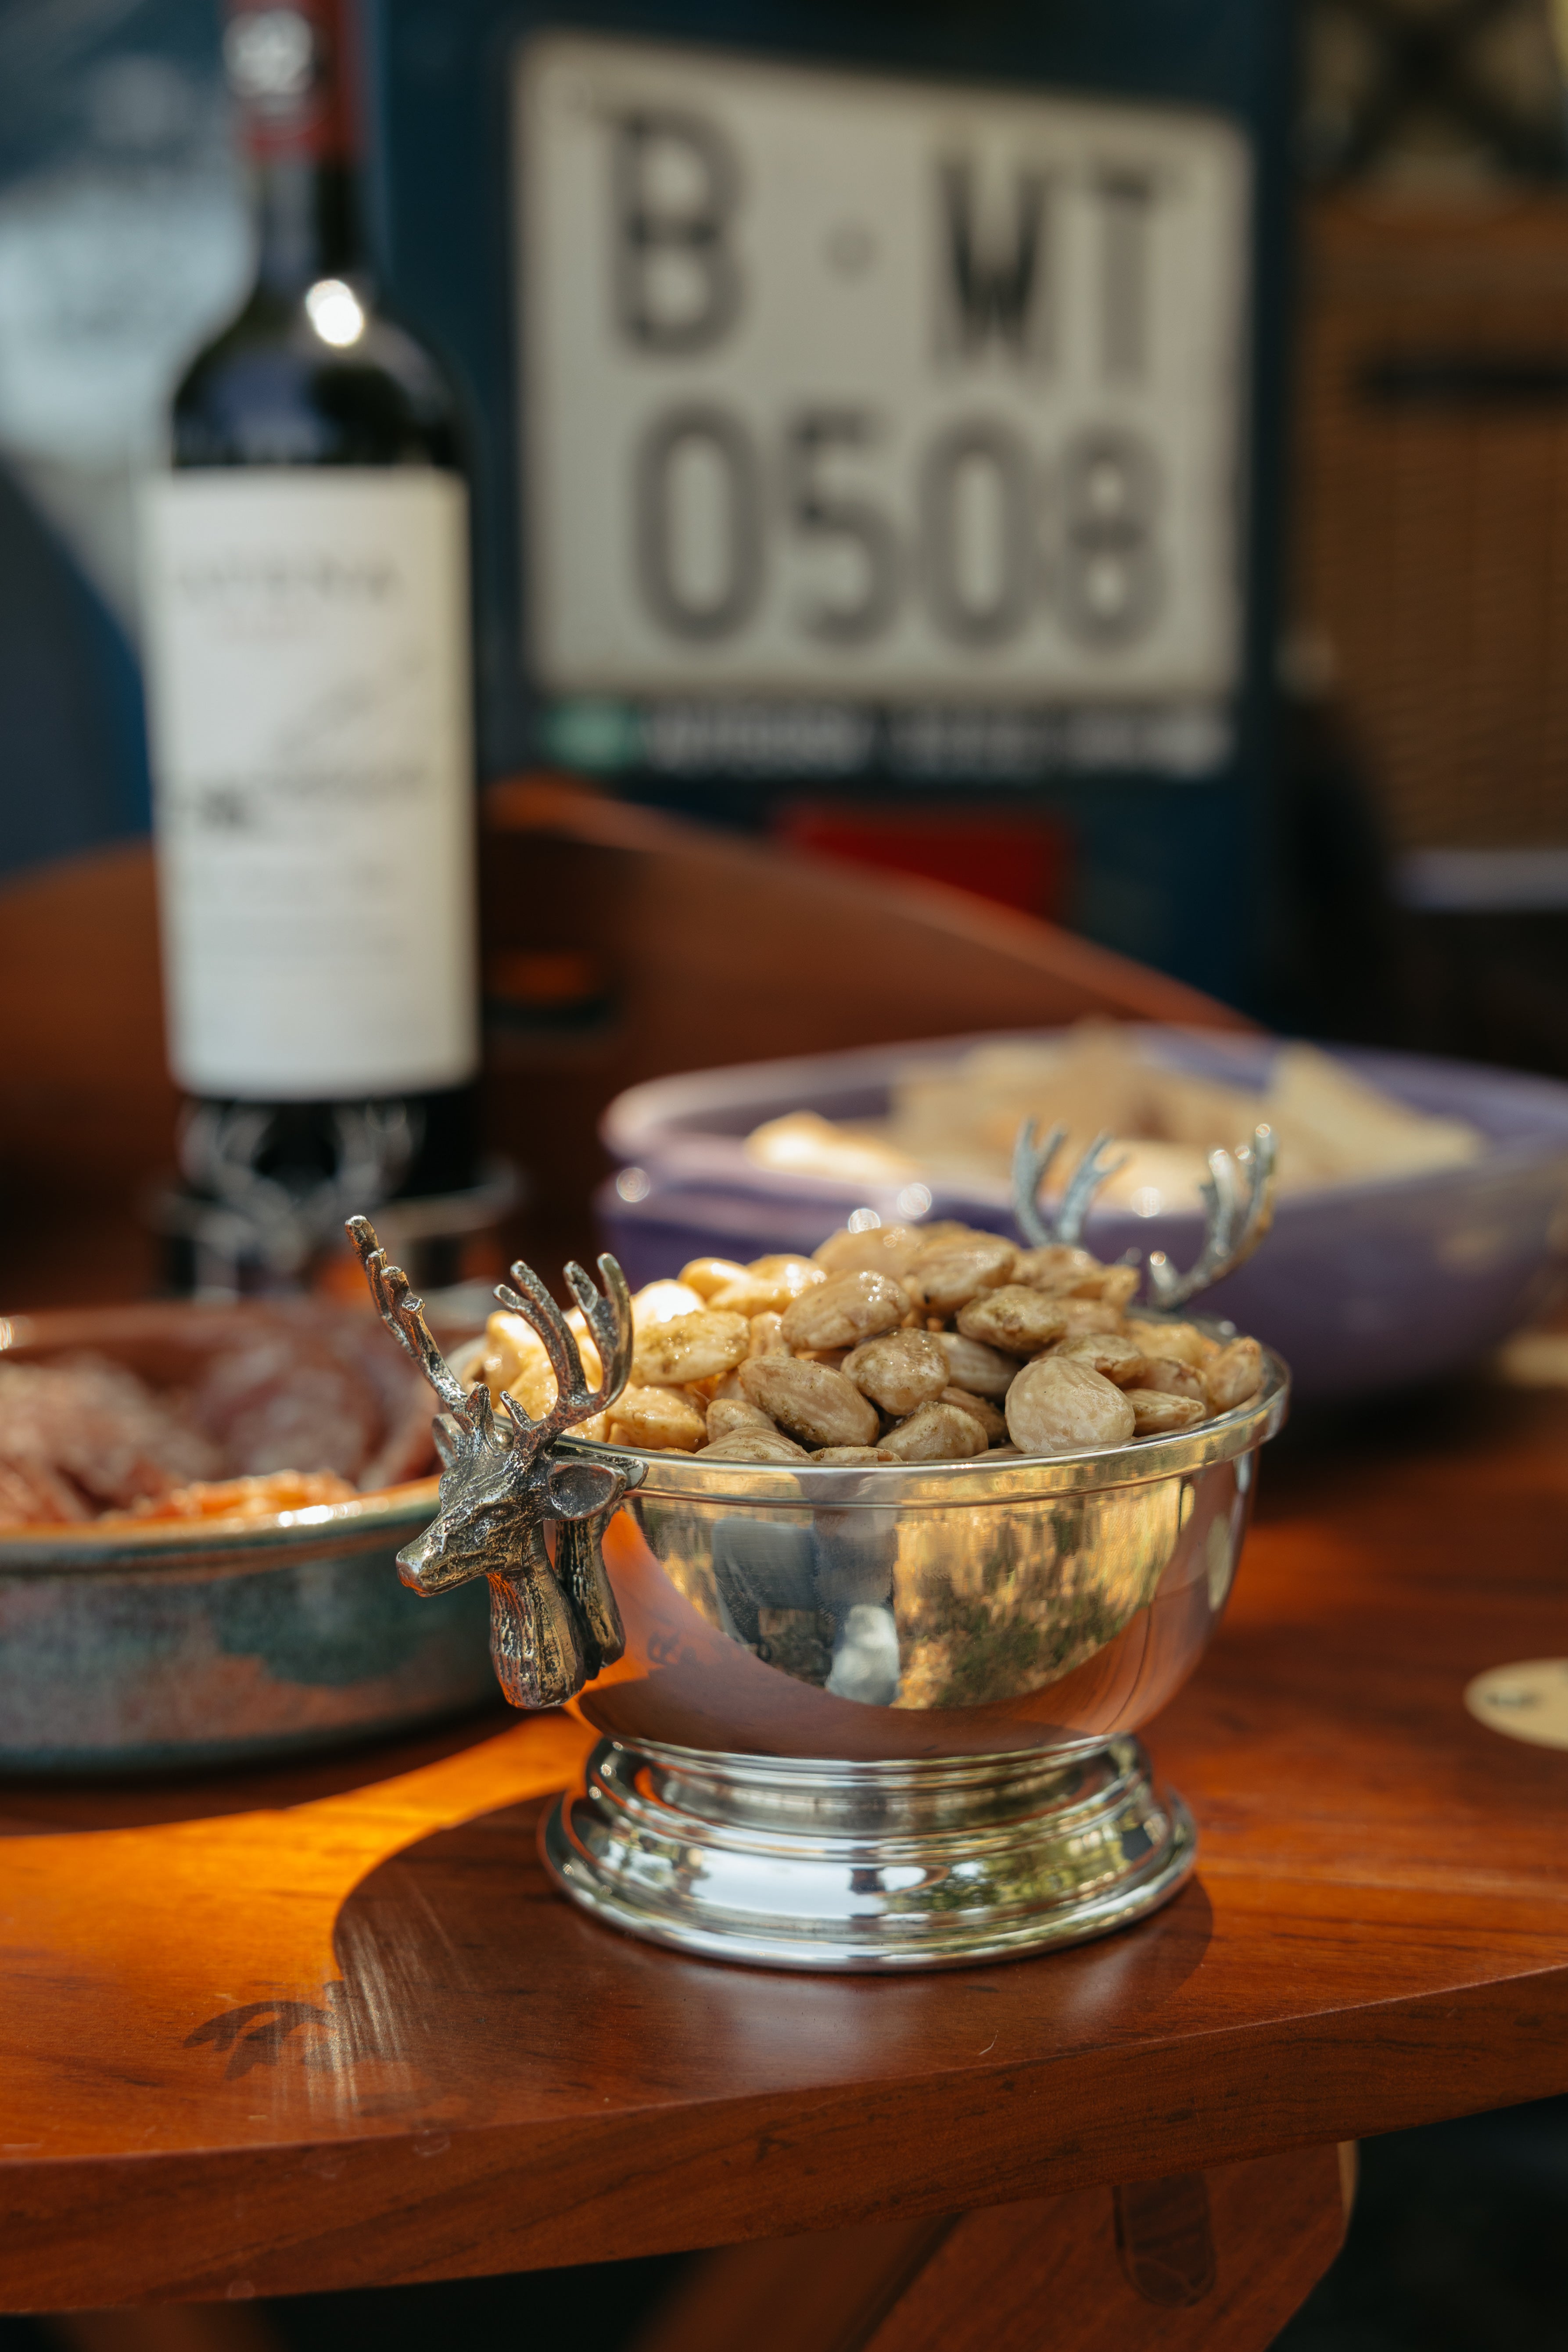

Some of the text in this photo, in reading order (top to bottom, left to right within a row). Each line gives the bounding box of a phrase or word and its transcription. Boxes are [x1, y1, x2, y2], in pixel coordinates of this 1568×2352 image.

[610, 105, 1176, 386] B WT
[628, 398, 1168, 653] 0508
